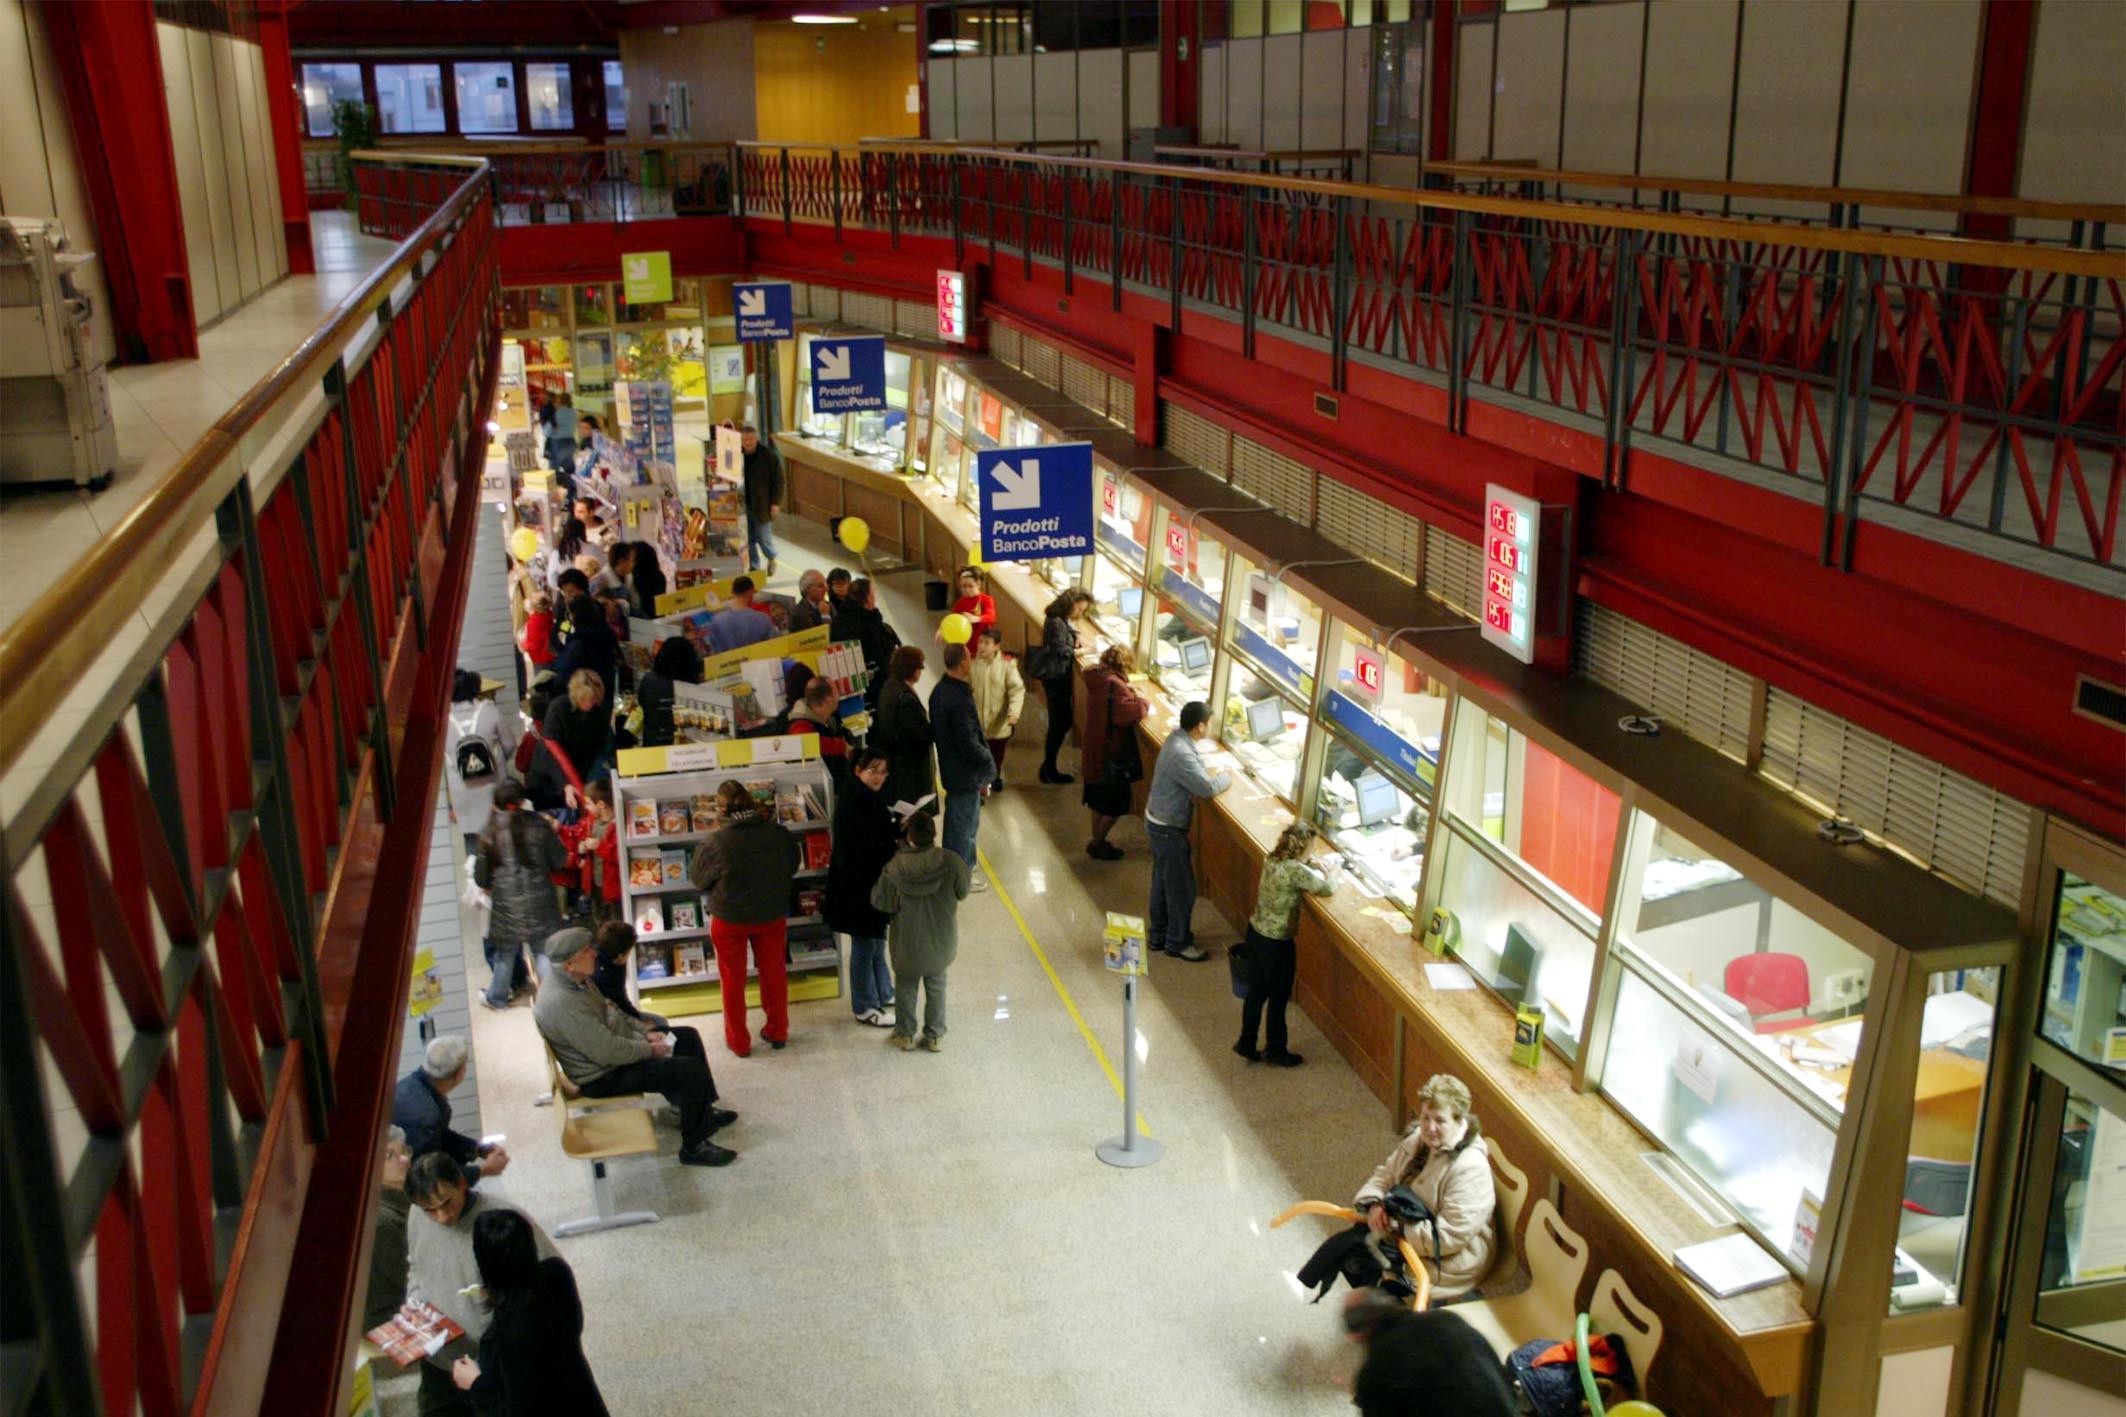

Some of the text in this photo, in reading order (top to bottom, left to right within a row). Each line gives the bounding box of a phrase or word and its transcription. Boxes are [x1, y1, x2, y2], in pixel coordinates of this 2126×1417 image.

[819, 384, 863, 397] Prodotti
[820, 396, 881, 408] BancoPosta
[992, 516, 1060, 535] Prodotti
[993, 535, 1086, 554] BancoPosta
